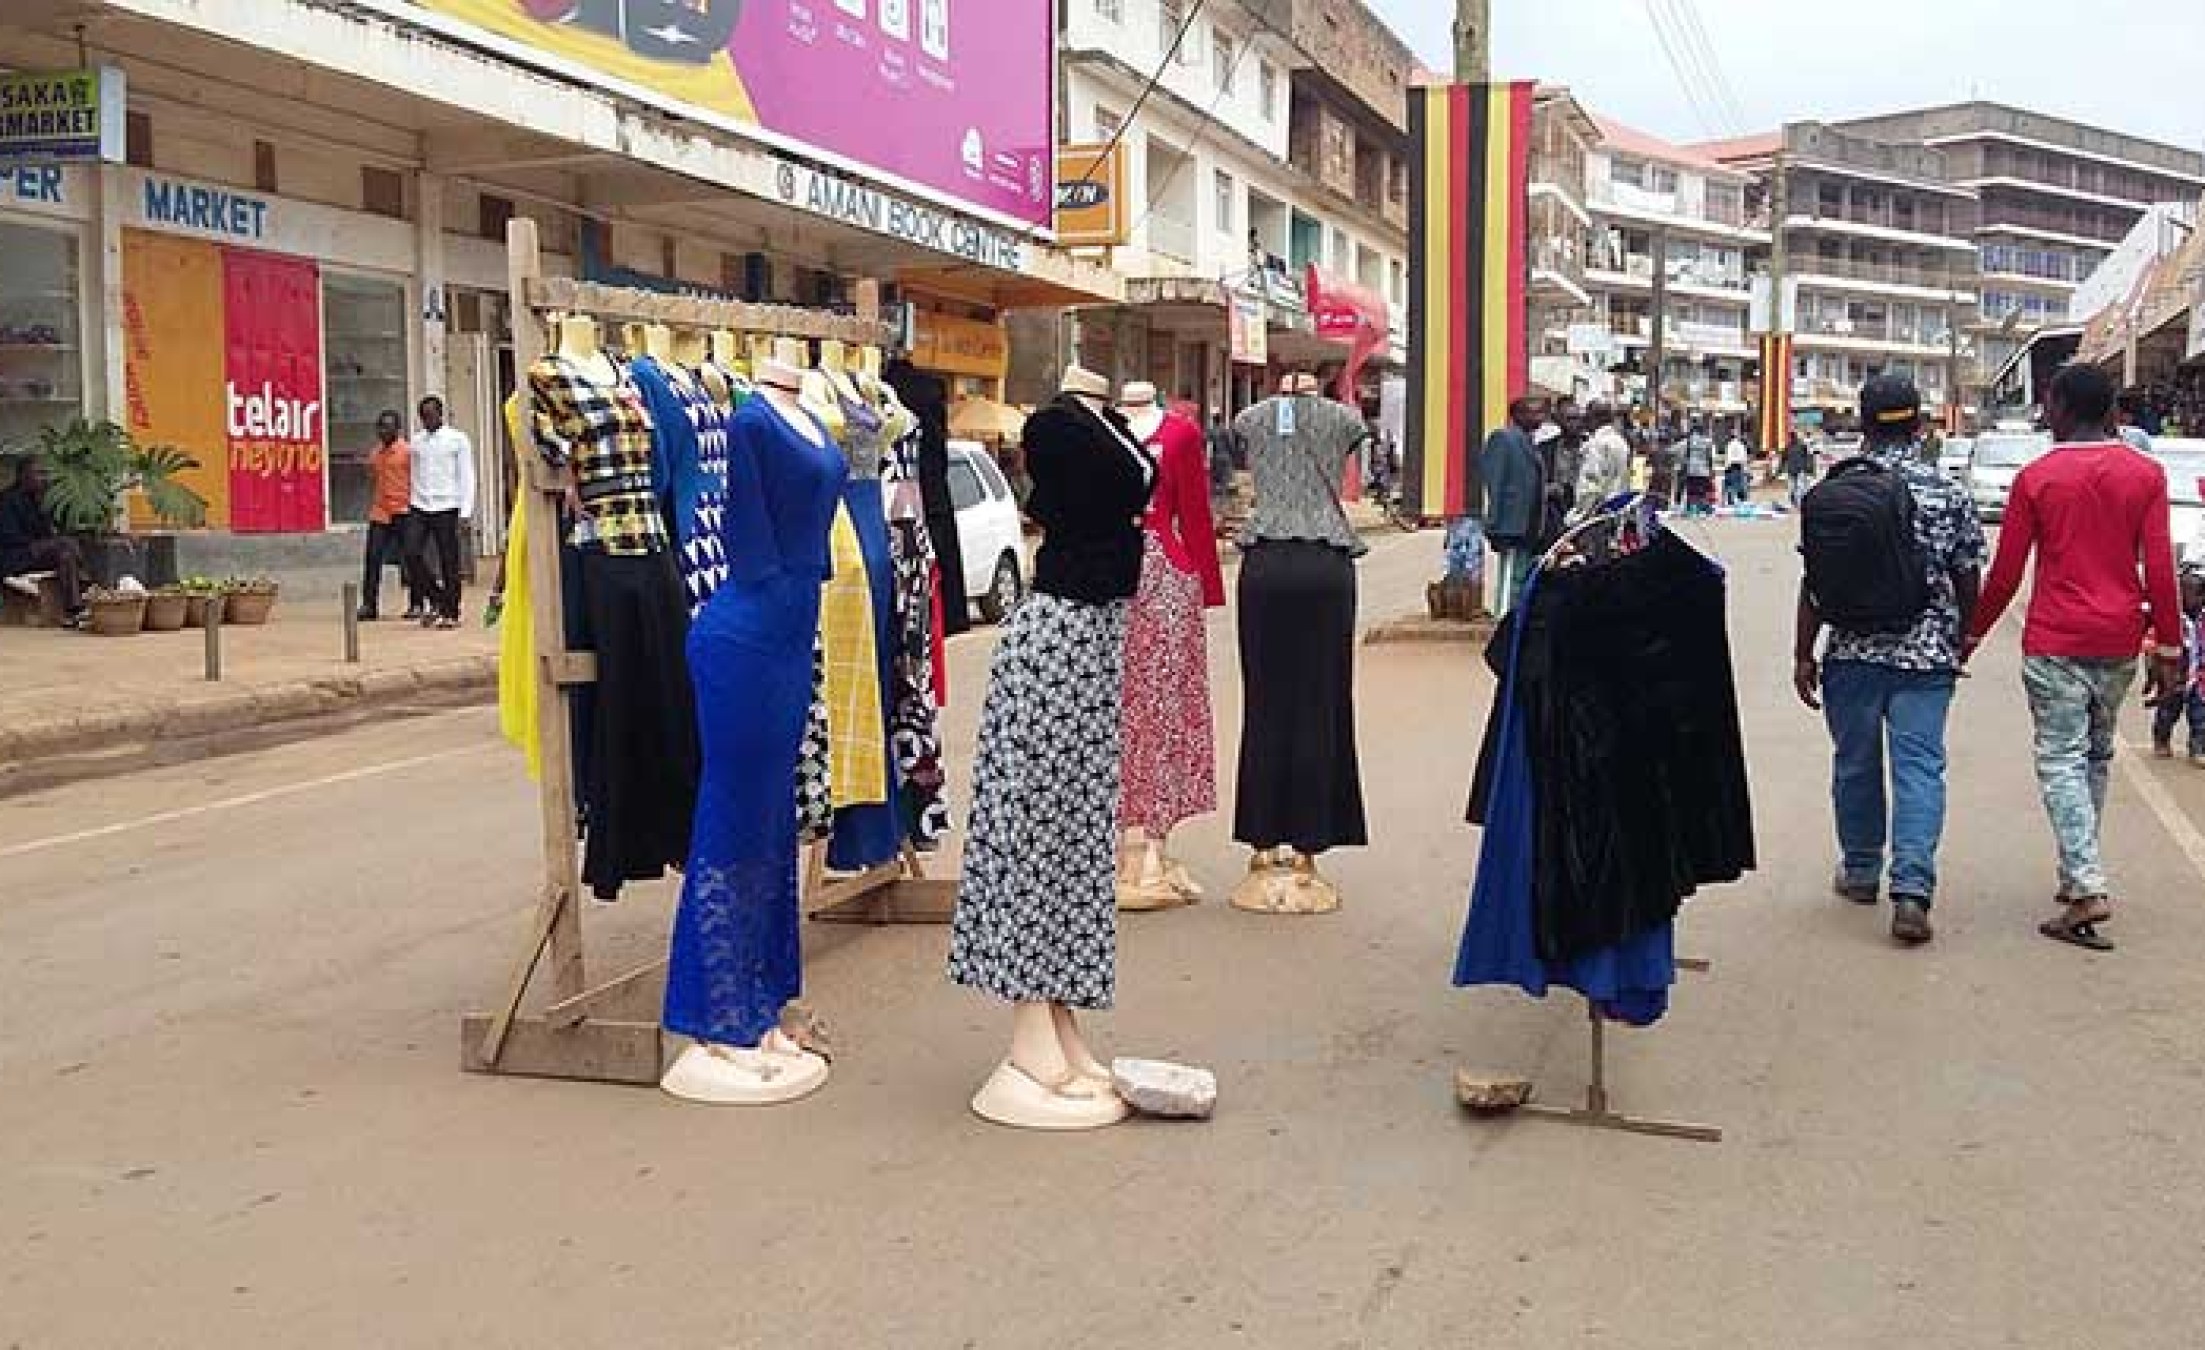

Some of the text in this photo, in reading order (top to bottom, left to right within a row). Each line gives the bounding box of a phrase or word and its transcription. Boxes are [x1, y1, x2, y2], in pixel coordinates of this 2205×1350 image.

[0, 108, 96, 137] MARKET
[144, 175, 266, 238] MARKET
[807, 171, 883, 231] AMANI
[889, 200, 943, 248] BOOK
